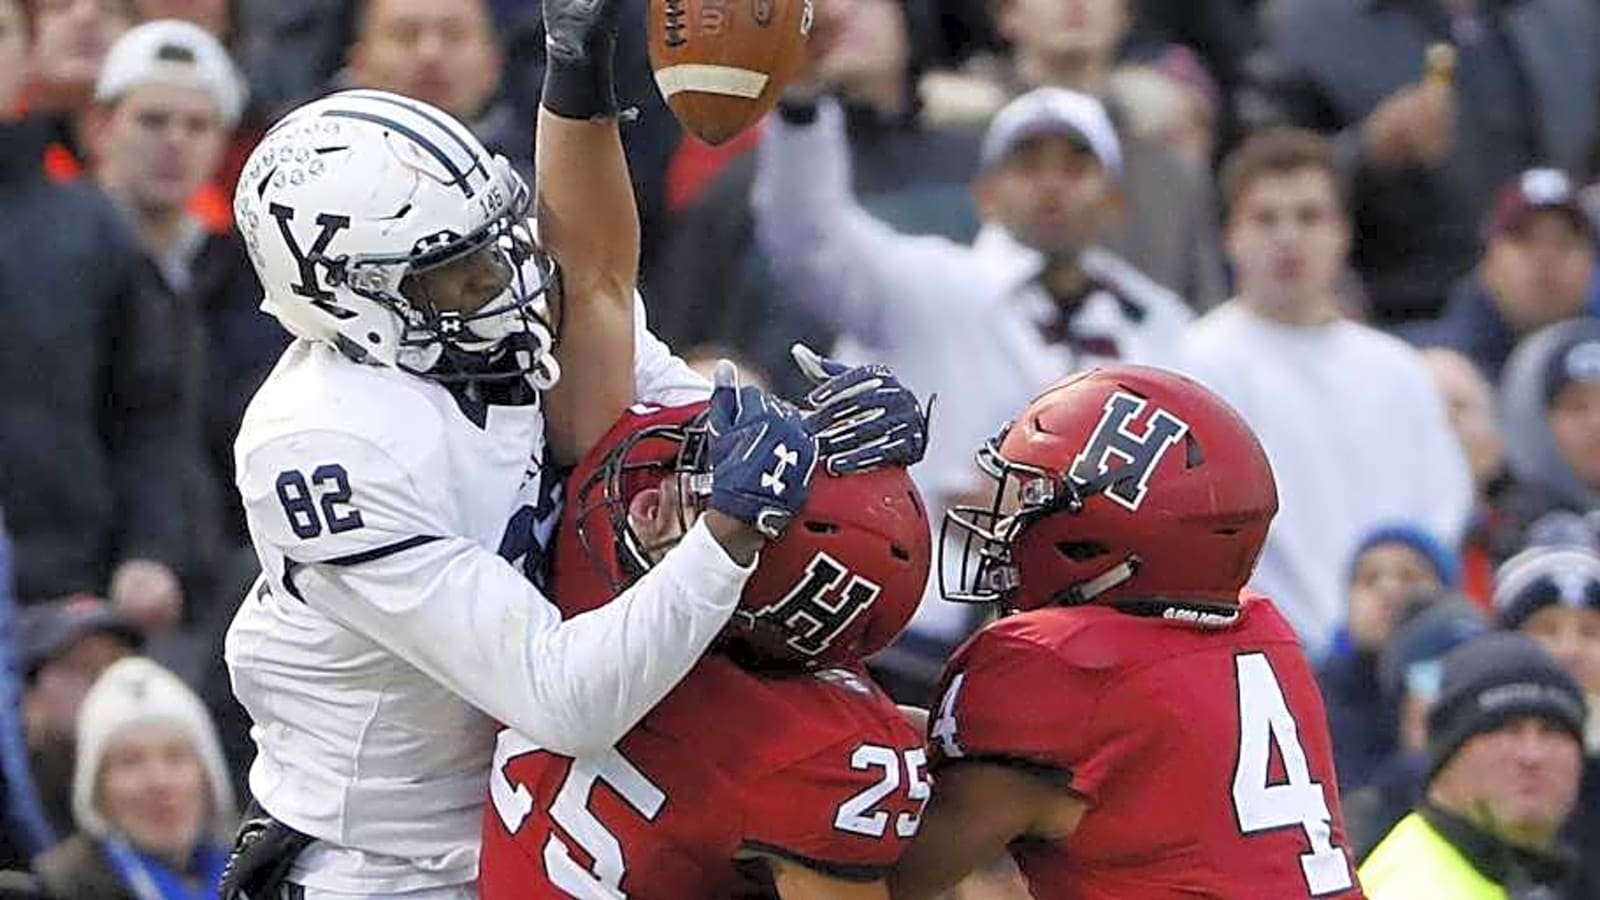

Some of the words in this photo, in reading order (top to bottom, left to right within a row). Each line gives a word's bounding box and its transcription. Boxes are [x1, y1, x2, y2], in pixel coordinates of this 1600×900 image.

[269, 202, 350, 301] Y
[1068, 391, 1188, 511] H
[276, 464, 365, 540] 82
[756, 551, 881, 655] H
[834, 744, 931, 837] 25
[1233, 652, 1352, 896] 4
